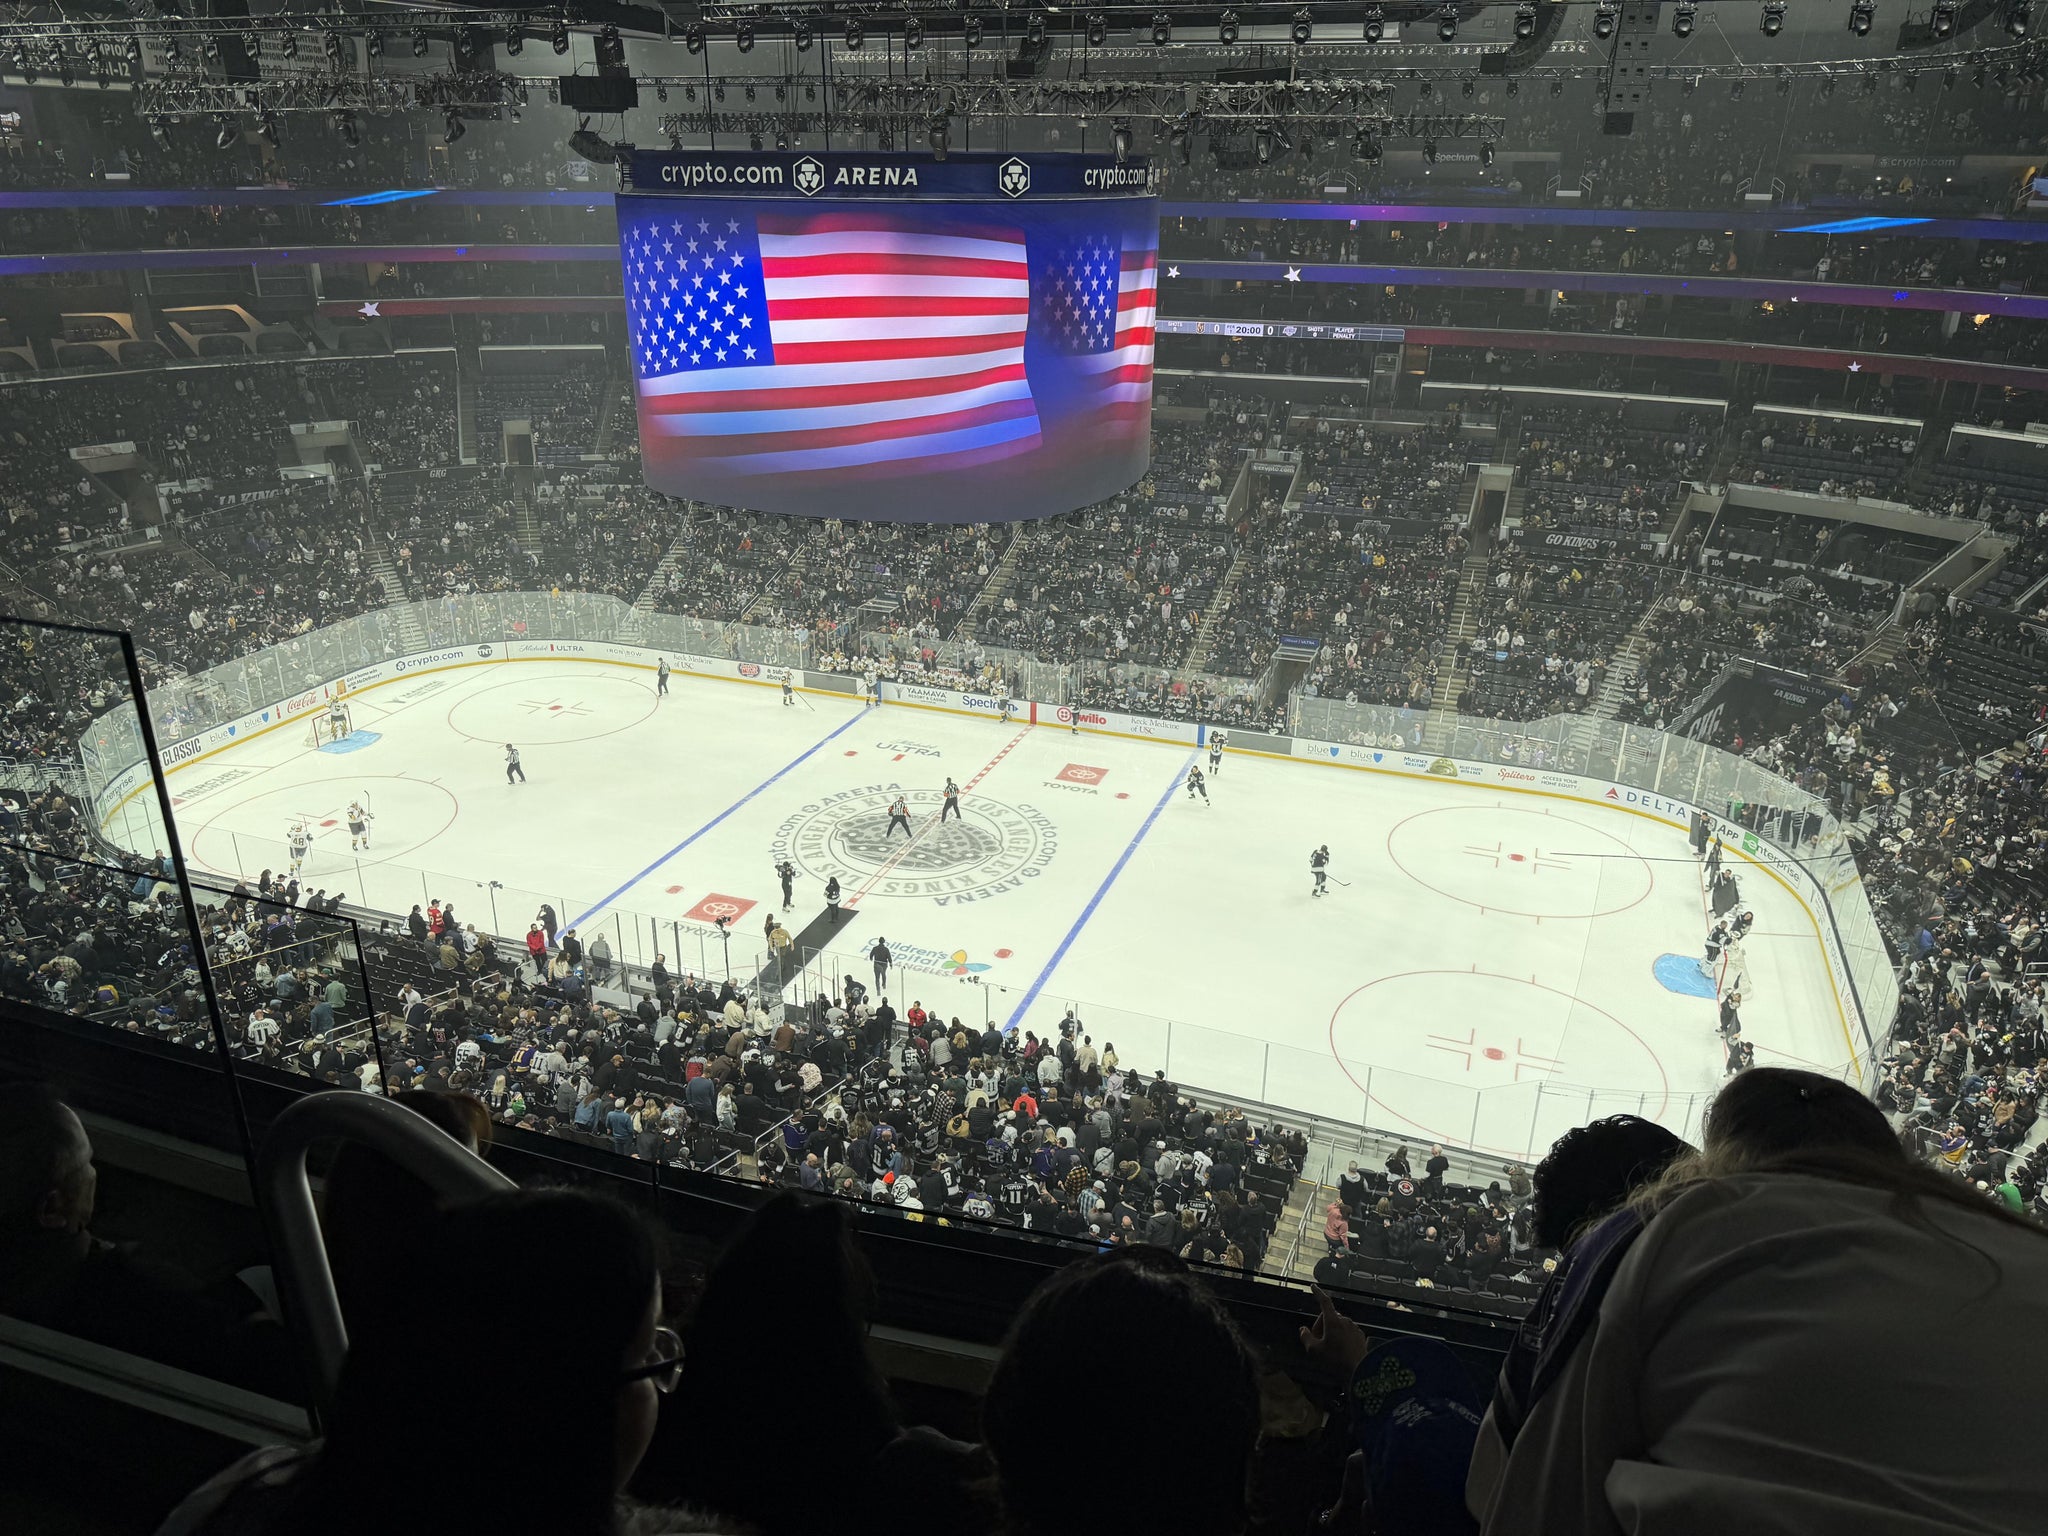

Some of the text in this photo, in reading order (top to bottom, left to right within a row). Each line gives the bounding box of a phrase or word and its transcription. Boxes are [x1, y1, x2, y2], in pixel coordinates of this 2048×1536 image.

[1435, 152, 1477, 164] Spectrum
[1890, 158, 1956, 168] crypto.com
[661, 162, 919, 187] crypto.com ARENA
[1084, 164, 1146, 189] crypto.com
[1213, 324, 1220, 333] 0
[1236, 326, 1261, 334] 20:00
[1267, 326, 1274, 335] 0
[429, 468, 447, 478] GKG
[219, 495, 236, 506] LA
[1512, 529, 1524, 537] 103
[1545, 533, 1562, 545] GO
[1562, 535, 1599, 549] KINGS
[1711, 558, 1724, 568] 104
[407, 650, 464, 668] crypto.com
[1773, 688, 1808, 704] LA KINGS
[1800, 684, 1828, 697] ULTRA
[244, 716, 262, 728] blue
[1078, 713, 1107, 725] wilio
[1131, 717, 1180, 730] Keck Medicine
[209, 729, 229, 743] blue
[1139, 726, 1155, 735] USC
[162, 737, 202, 767] CLASSIC
[876, 741, 941, 758] ULTRA
[1307, 743, 1329, 754] blue
[1350, 750, 1373, 760] blue
[1497, 768, 1536, 782] Splitero
[1563, 777, 1578, 785] YOUR
[1041, 781, 1099, 795] TOYOTA
[1541, 780, 1577, 790] HOME EQUITY
[820, 782, 902, 806] ARENA
[864, 791, 944, 807] KINGS
[963, 798, 1010, 818] LOS
[1626, 791, 1686, 819] DELTA
[800, 804, 857, 860] ANGELES
[1017, 803, 1058, 867] crypto.com
[292, 837, 305, 846] 48
[981, 820, 1031, 878] ANGELES
[1747, 840, 1801, 883] enterprise
[883, 873, 979, 895] KINGS
[934, 875, 1024, 907] ARENA
[662, 921, 725, 940] TOYOTA
[894, 961, 950, 978] ANGELES
[255, 1028, 269, 1042] 11
[456, 1048, 470, 1062] 55
[905, 1054, 917, 1067] 55
[534, 1057, 544, 1071] 11
[987, 1081, 995, 1092] 11
[1010, 1190, 1021, 1204] 11
